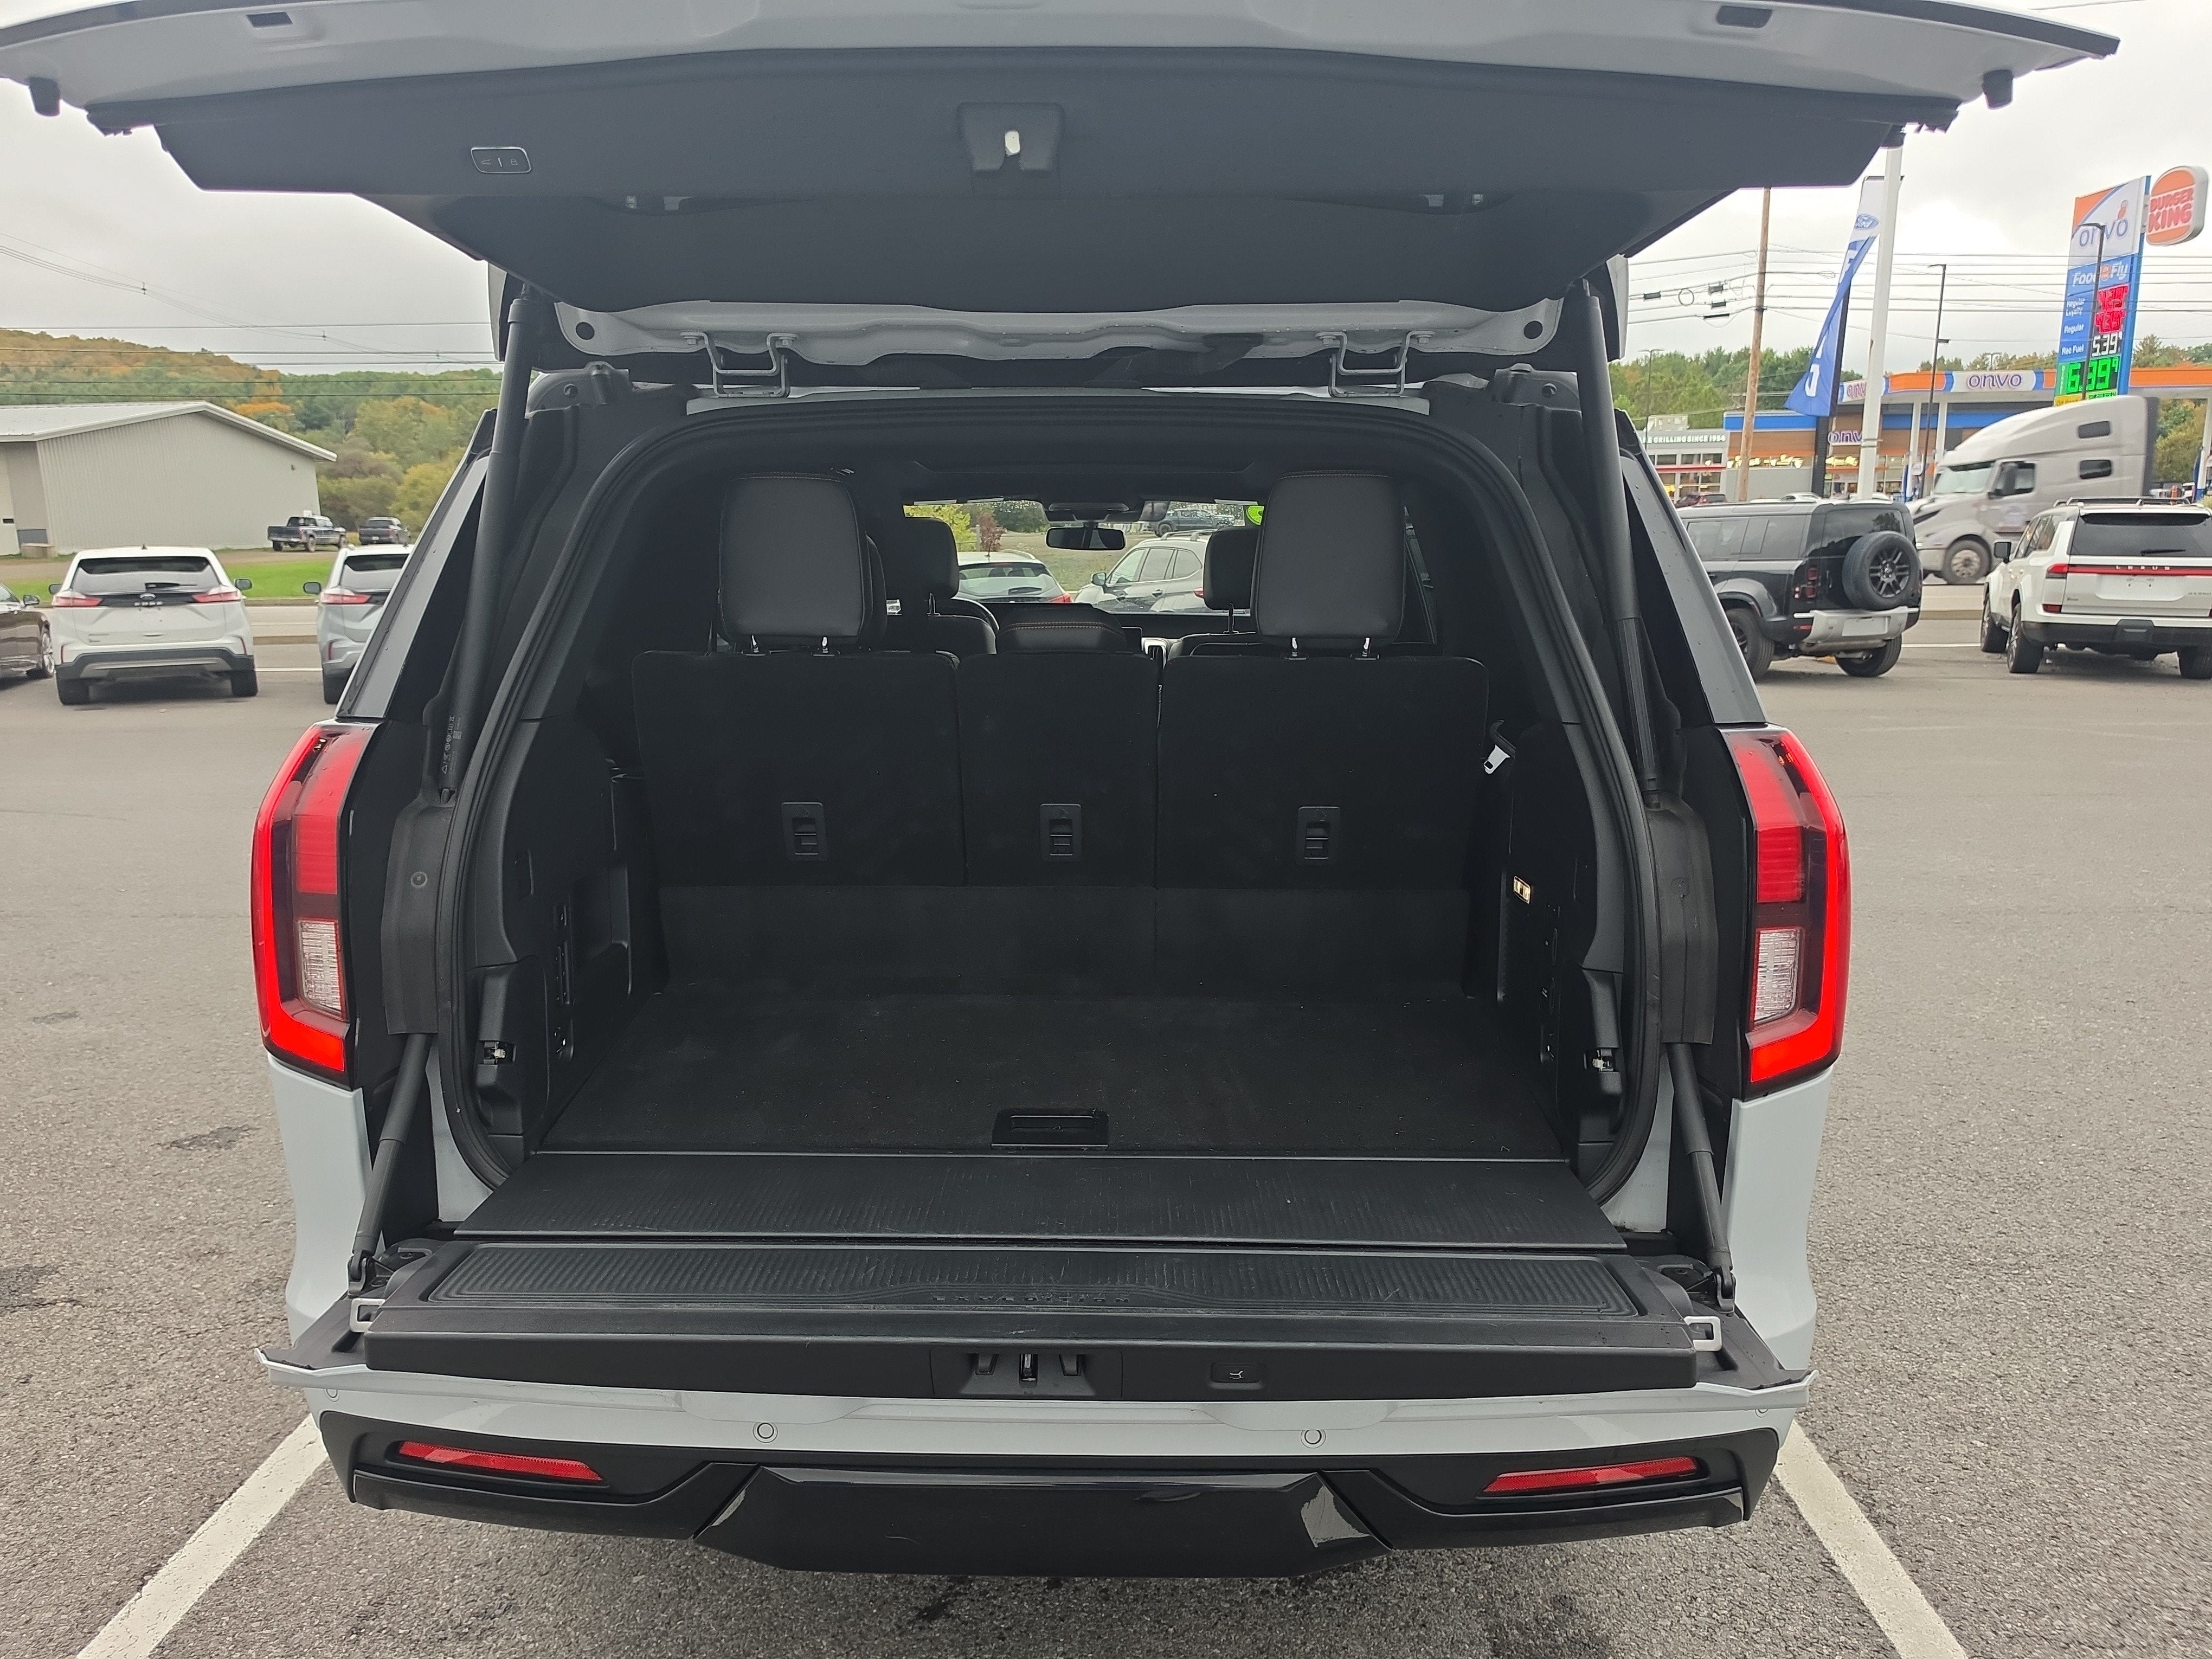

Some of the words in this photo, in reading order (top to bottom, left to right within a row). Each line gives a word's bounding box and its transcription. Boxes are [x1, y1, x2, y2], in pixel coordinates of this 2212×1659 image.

[2150, 188, 2194, 213] BURGER
[2148, 203, 2191, 233] KING
[2111, 261, 2129, 280] Fly
[2064, 323, 2085, 334] Regular
[2073, 344, 2084, 353] Fuel
[1968, 374, 2022, 388] onvo
[1847, 383, 1867, 397] onv
[1687, 435, 1708, 443] SINCE
[1828, 431, 1862, 443] onv
